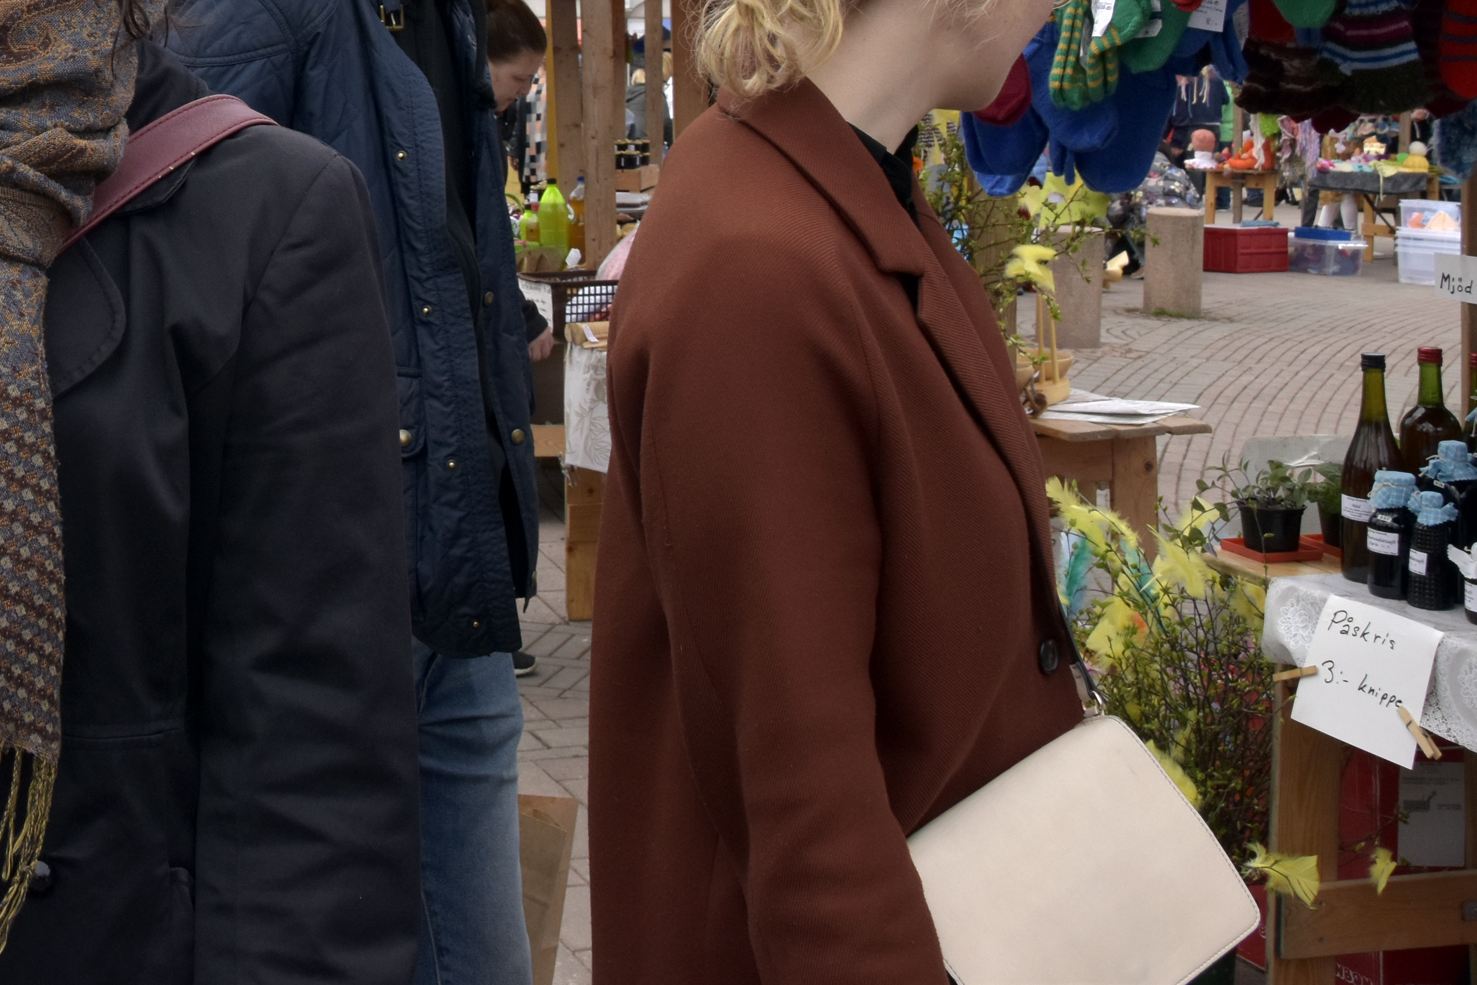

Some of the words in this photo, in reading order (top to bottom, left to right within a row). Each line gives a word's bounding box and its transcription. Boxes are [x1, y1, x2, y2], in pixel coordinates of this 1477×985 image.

[1440, 272, 1473, 295] Mjöd
[1327, 609, 1396, 650] Påskris
[1321, 660, 1349, 684] 3:-
[1357, 673, 1403, 708] knippe
